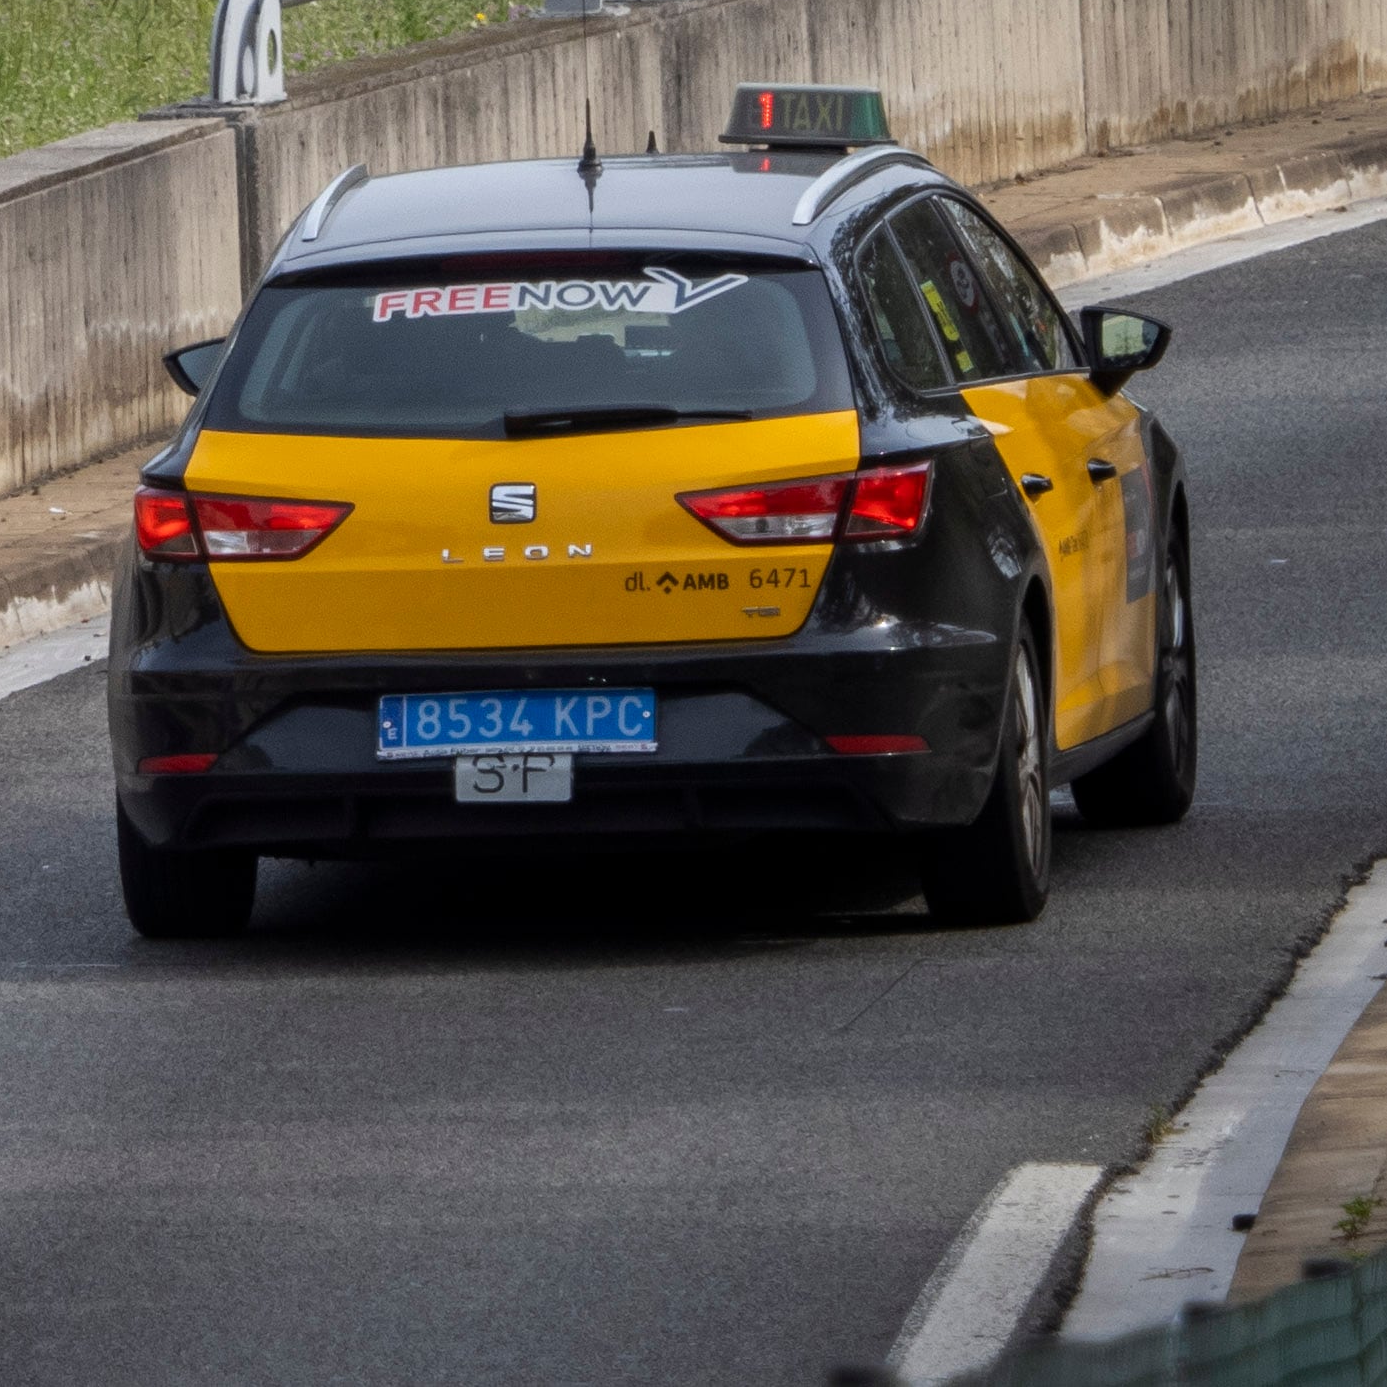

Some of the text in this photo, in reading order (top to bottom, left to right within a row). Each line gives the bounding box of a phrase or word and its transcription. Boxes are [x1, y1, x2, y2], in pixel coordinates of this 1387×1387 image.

[781, 92, 844, 131] TAXI
[442, 544, 592, 563] LEON
[682, 573, 729, 591] AMB
[749, 568, 811, 589] 6471
[416, 697, 533, 741] 8534
[554, 695, 643, 738] KPC
